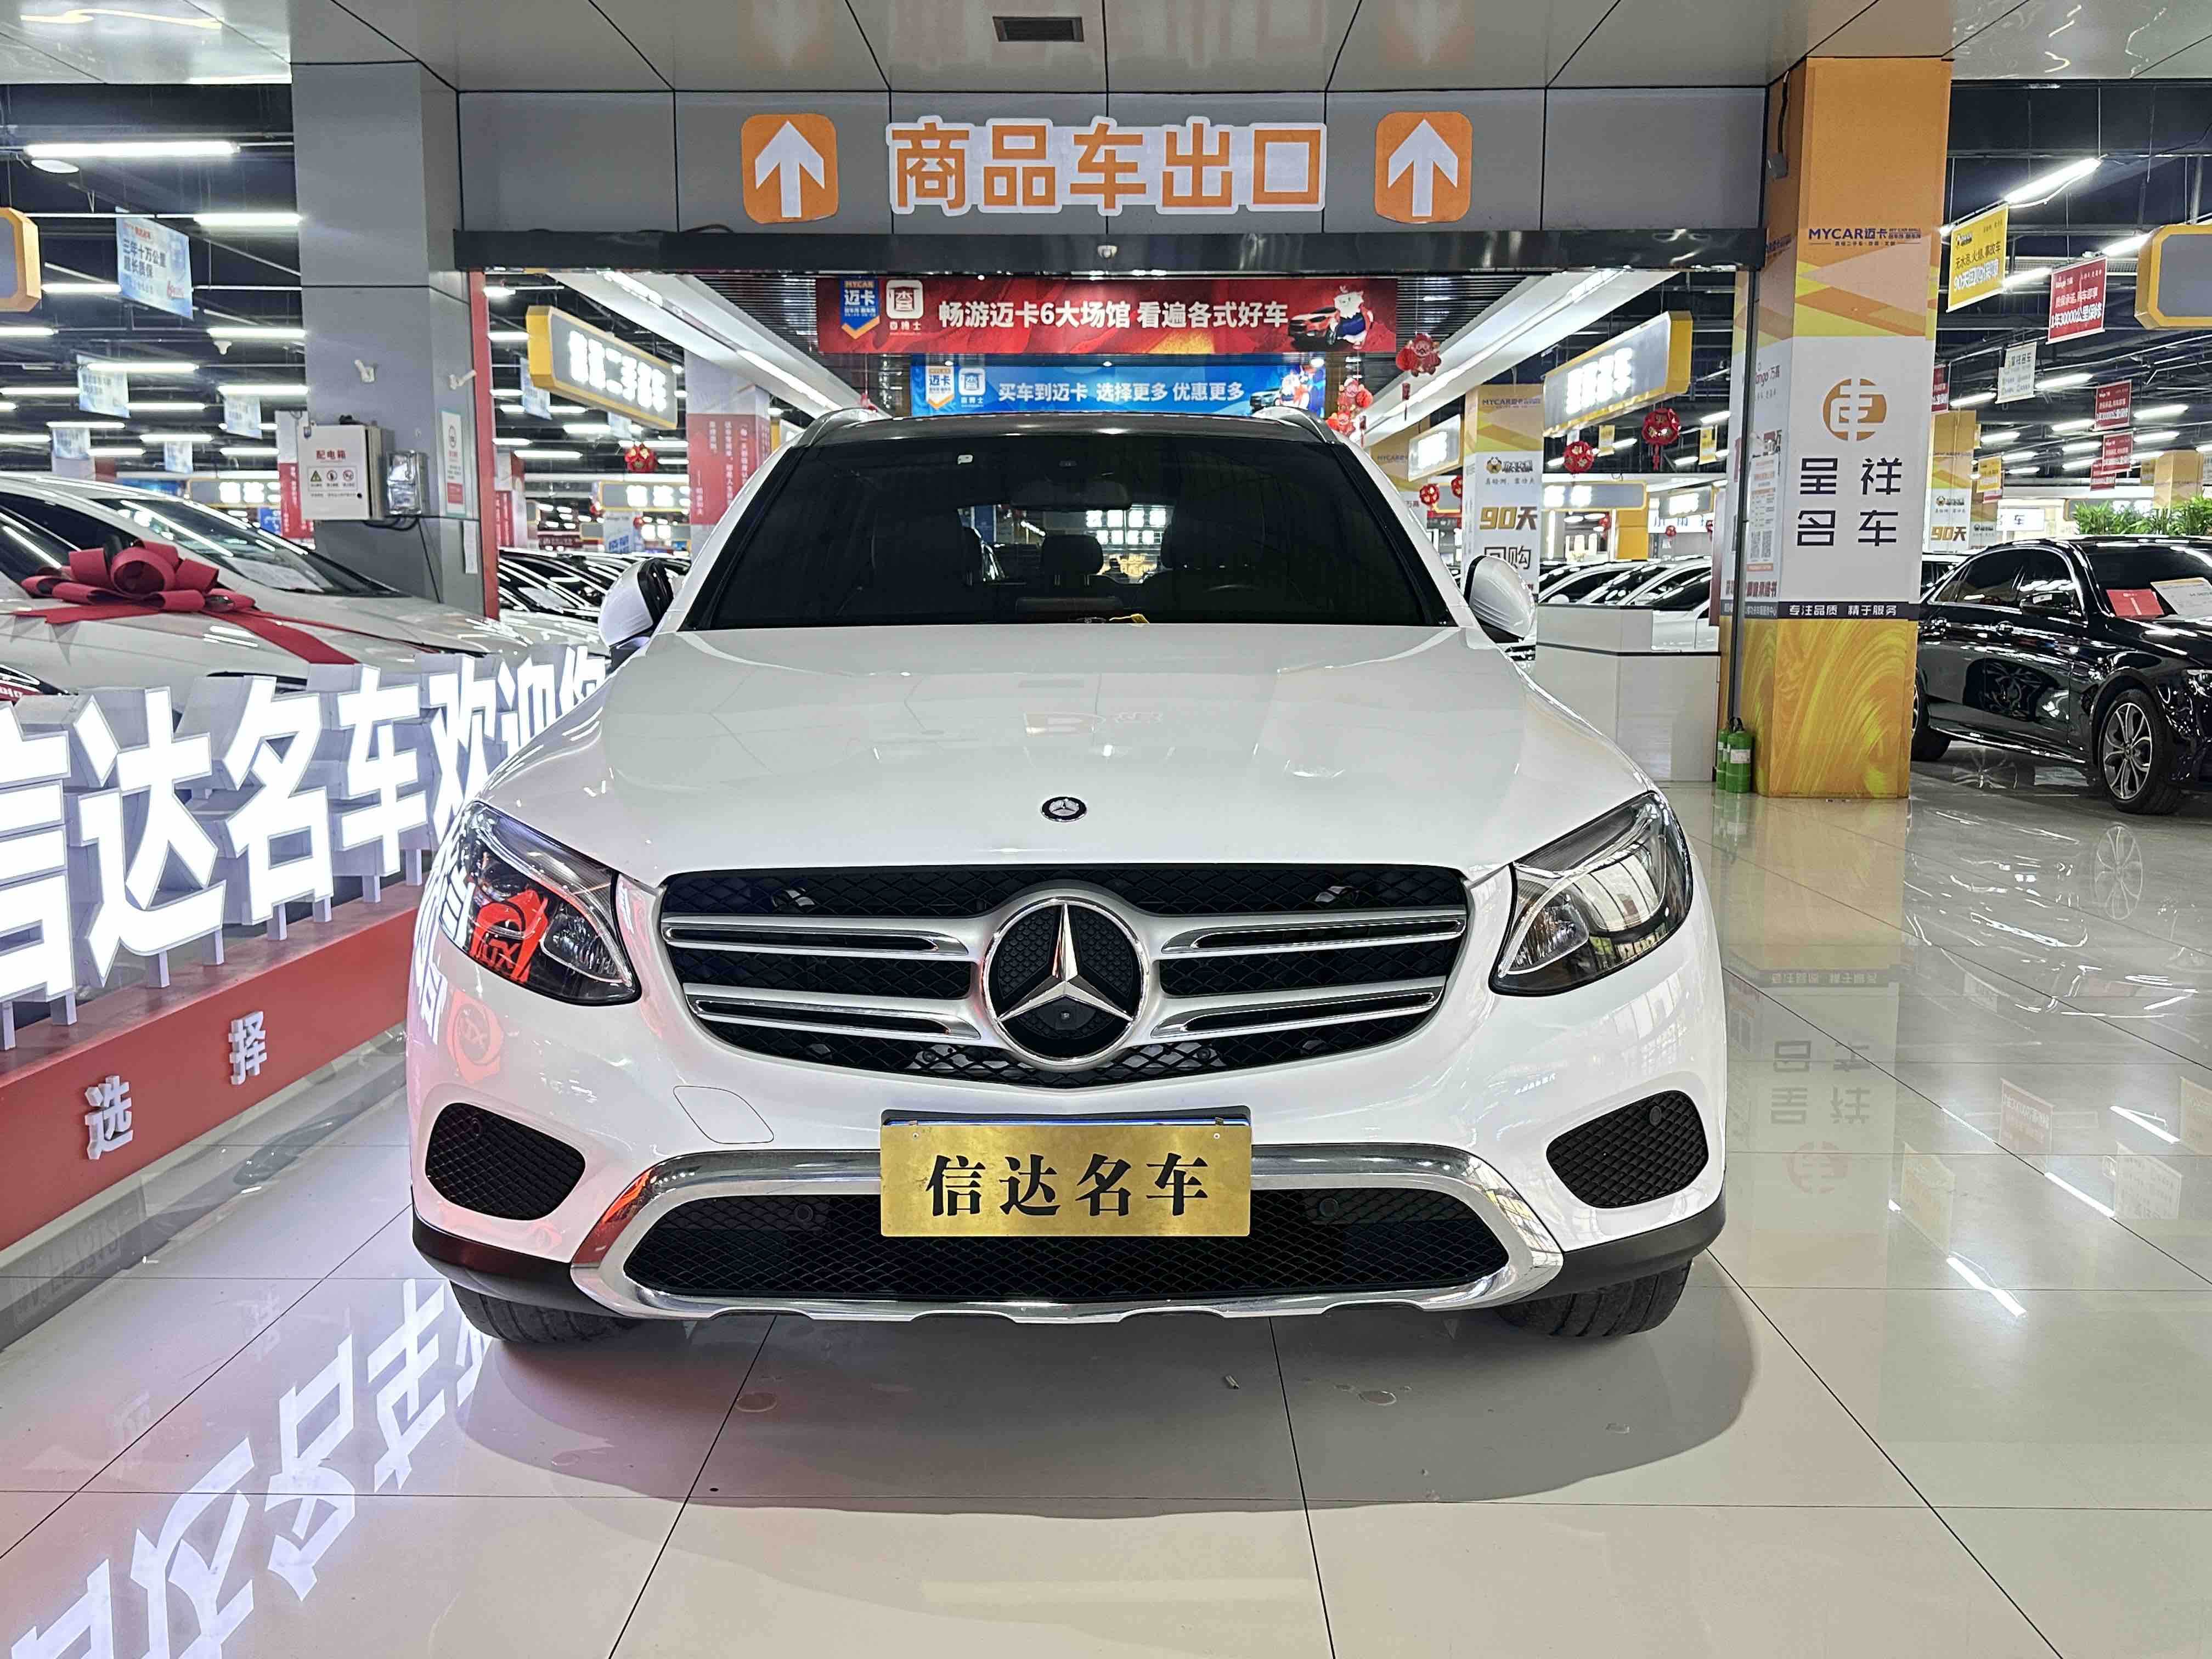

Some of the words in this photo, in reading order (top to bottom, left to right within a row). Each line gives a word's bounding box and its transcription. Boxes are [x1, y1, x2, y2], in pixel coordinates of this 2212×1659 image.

[891, 122, 1322, 210] 商品车出口
[844, 290, 876, 306] 迈卡
[939, 301, 1131, 329] 畅游迈卡6大场馆
[1137, 301, 1289, 329] 看遍各式好车
[930, 375, 951, 385] 迈卡
[997, 382, 1088, 402] 买车到迈卡
[1096, 381, 1168, 402] 选择更多
[1173, 380, 1245, 402] 优惠更多
[316, 449, 346, 460] 配电箱
[1799, 457, 1903, 496] 呈祥
[1479, 506, 1538, 531] 90天
[1796, 509, 1899, 548] 名车
[1931, 526, 1967, 541] 90天
[1788, 604, 1838, 616] 专注品质
[1848, 604, 1898, 616] 精于服务
[925, 1152, 1210, 1217] 信达名车
